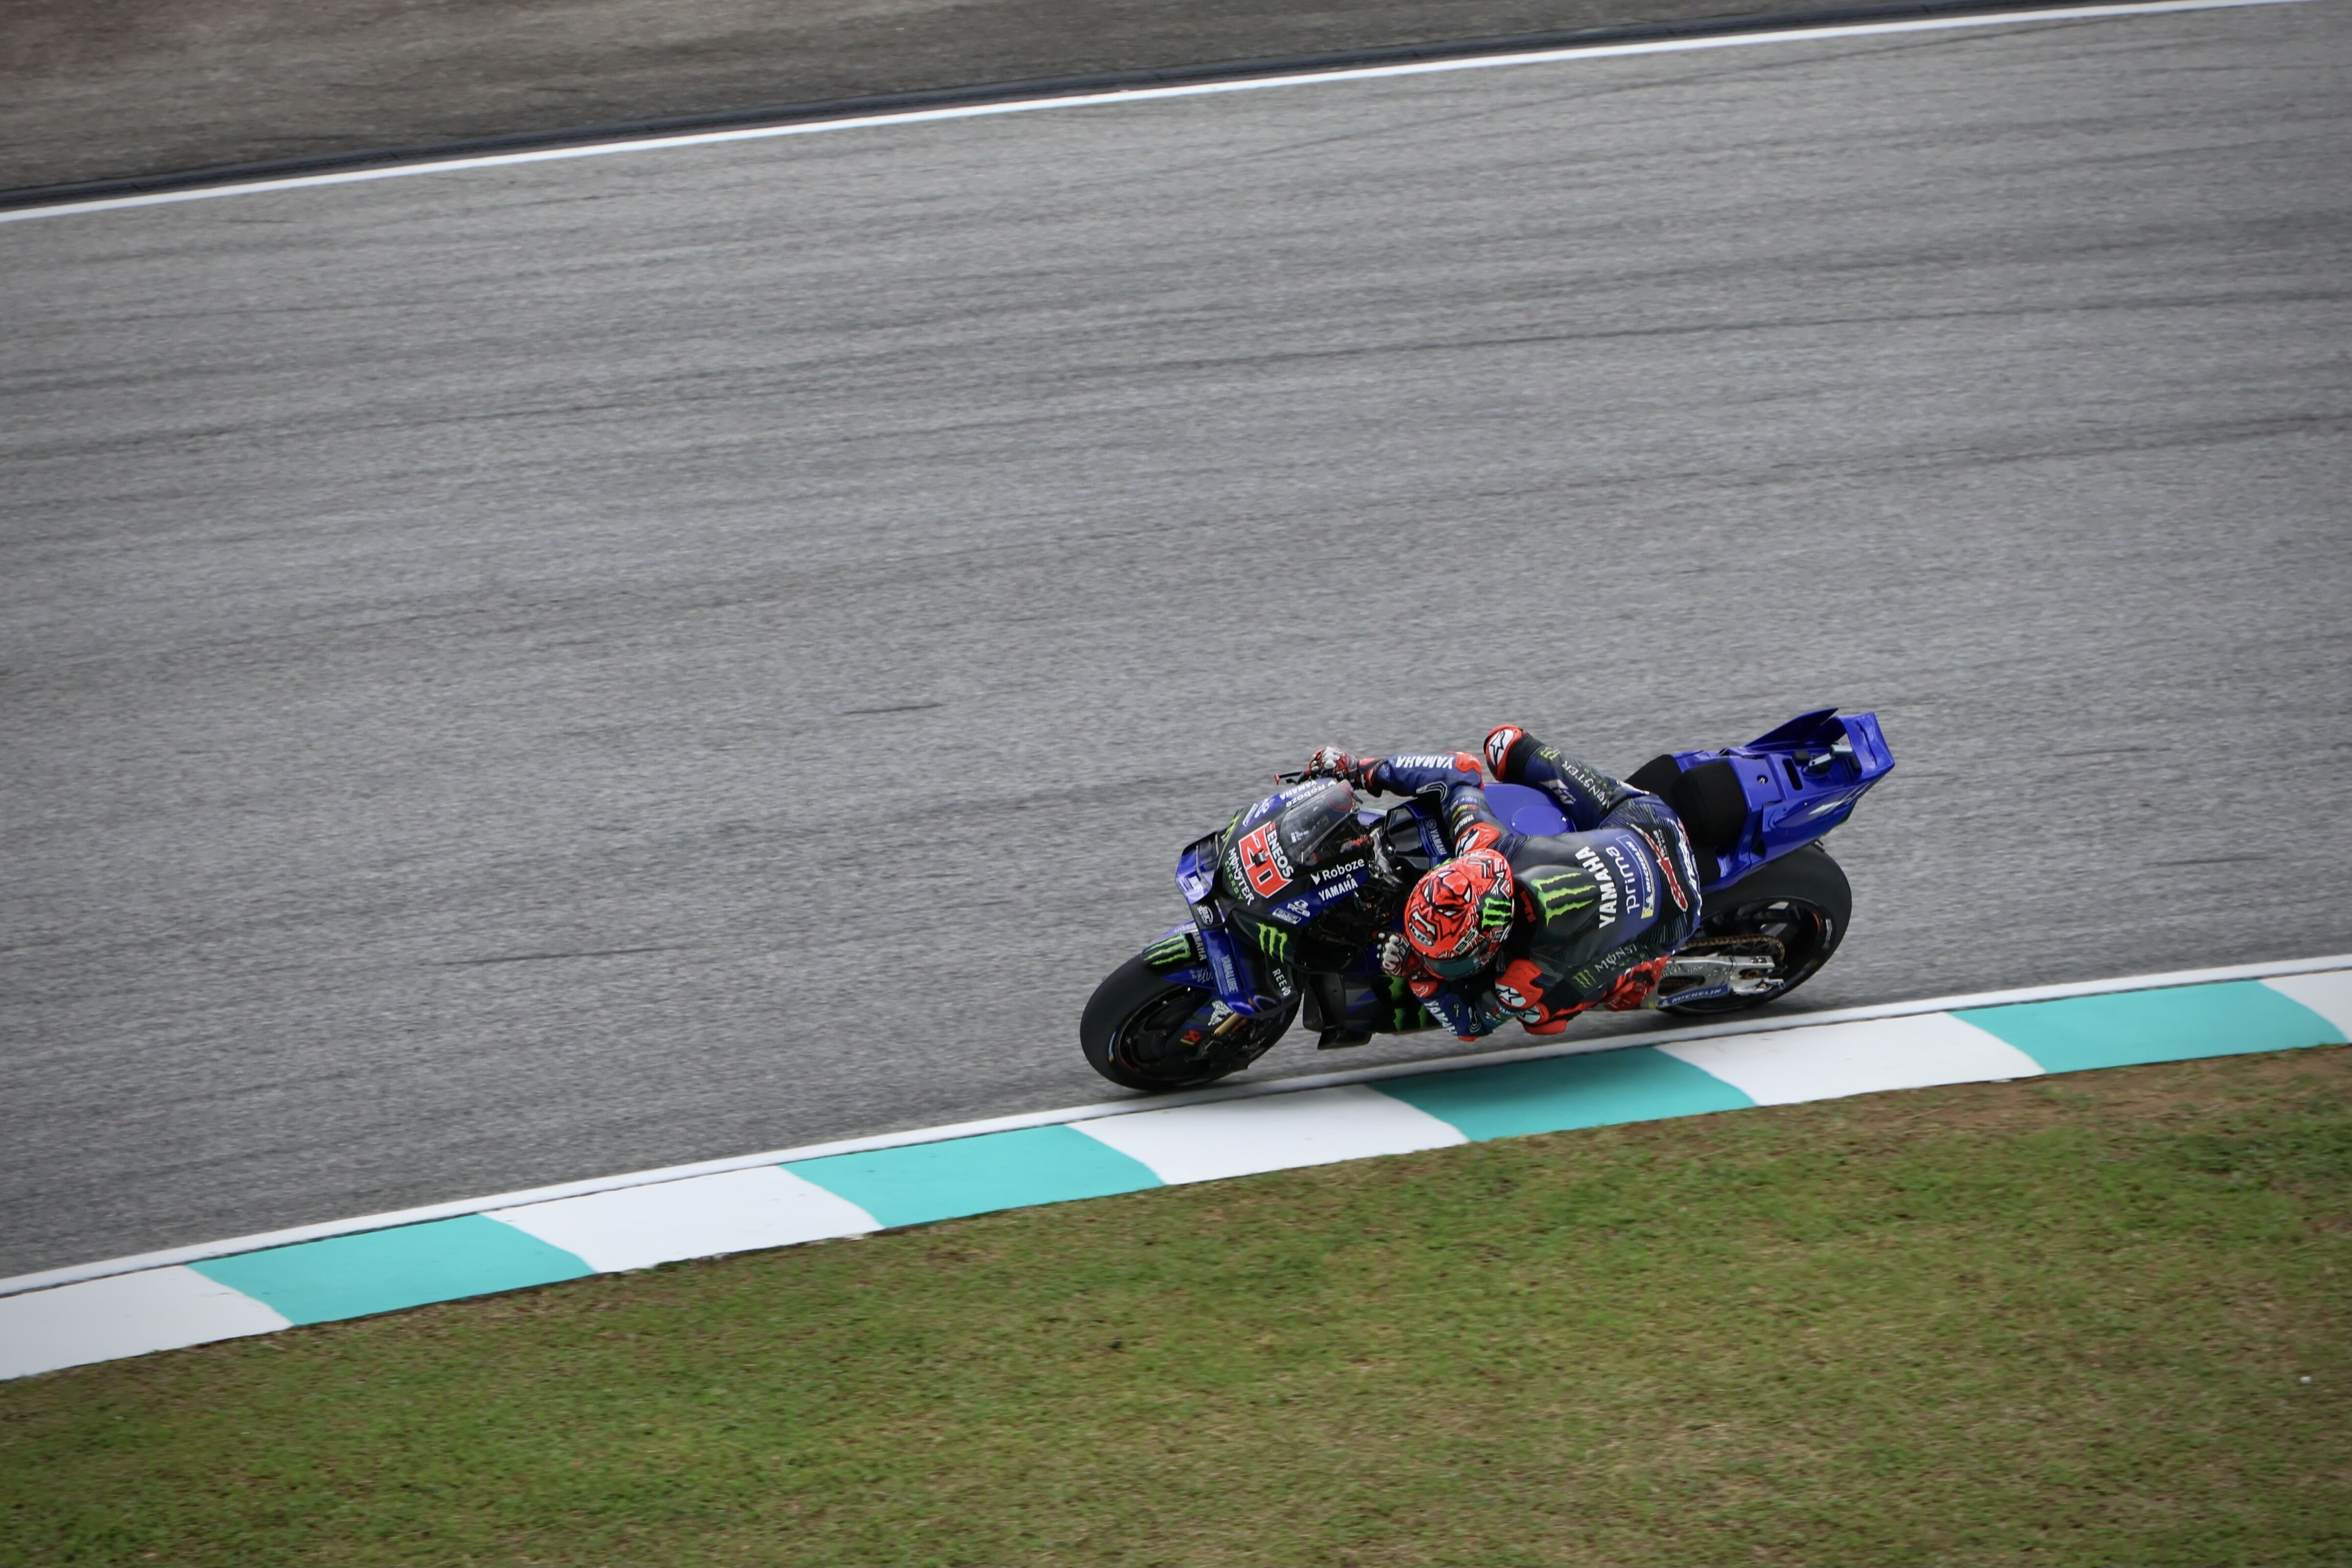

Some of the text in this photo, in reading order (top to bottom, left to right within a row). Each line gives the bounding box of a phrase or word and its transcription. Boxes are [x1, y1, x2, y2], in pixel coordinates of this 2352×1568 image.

[1395, 755, 1455, 770] YAMAHA
[1279, 780, 1317, 800] YAMAHA
[1285, 784, 1325, 807] Roboze
[1562, 760, 1613, 809] MONSTER
[1238, 821, 1294, 899] 20
[1267, 829, 1294, 879] ENEOS
[1322, 858, 1365, 881] Roboze
[1626, 841, 1652, 892] MICHELIN
[1224, 861, 1244, 901] ENERGY
[1228, 847, 1255, 906] MONSTER
[1318, 878, 1359, 902] YAMAHA
[1575, 846, 1618, 929] YAMAHA
[1605, 845, 1641, 914] prima
[1221, 955, 1239, 993] YAMALUBE
[1671, 987, 1722, 1003] MICHELIN
